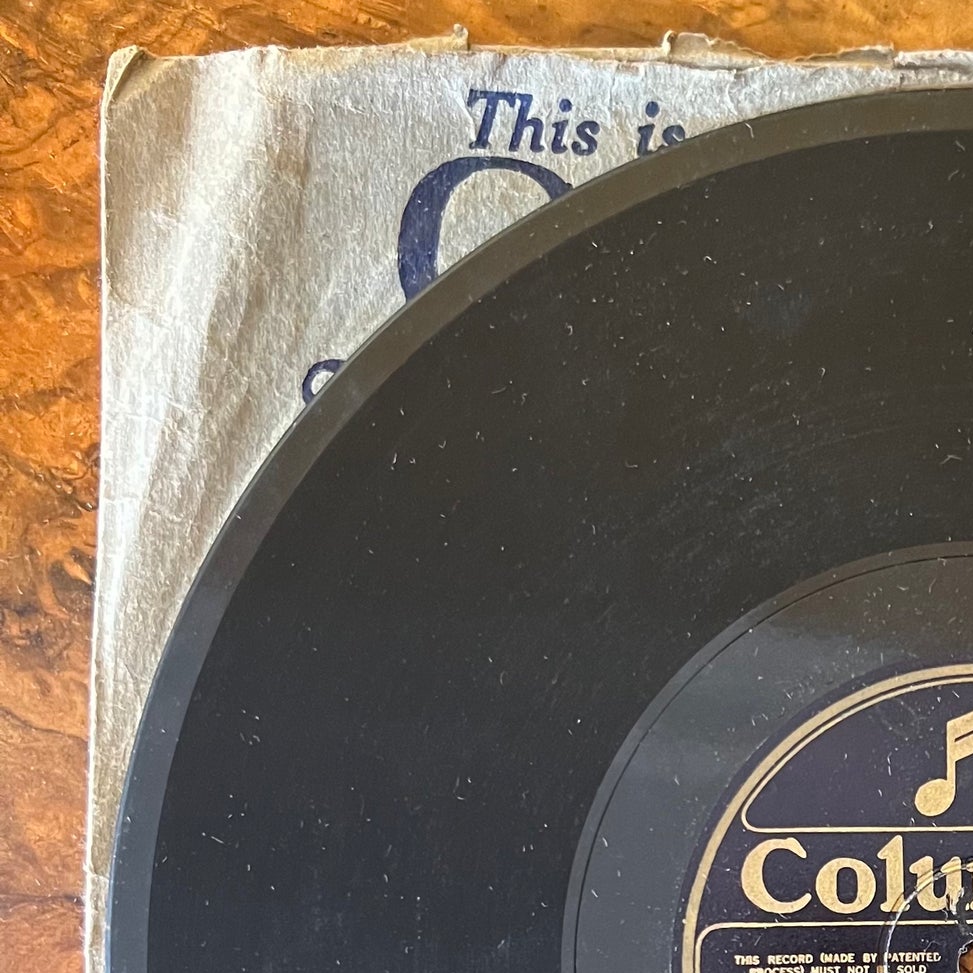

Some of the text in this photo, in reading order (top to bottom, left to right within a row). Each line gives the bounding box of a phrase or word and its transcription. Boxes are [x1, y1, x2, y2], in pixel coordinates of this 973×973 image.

[467, 88, 686, 157] This is
[734, 955, 760, 965] THIS
[767, 954, 814, 965] RECORD
[820, 953, 855, 963] (MADE
[862, 953, 878, 963] BY
